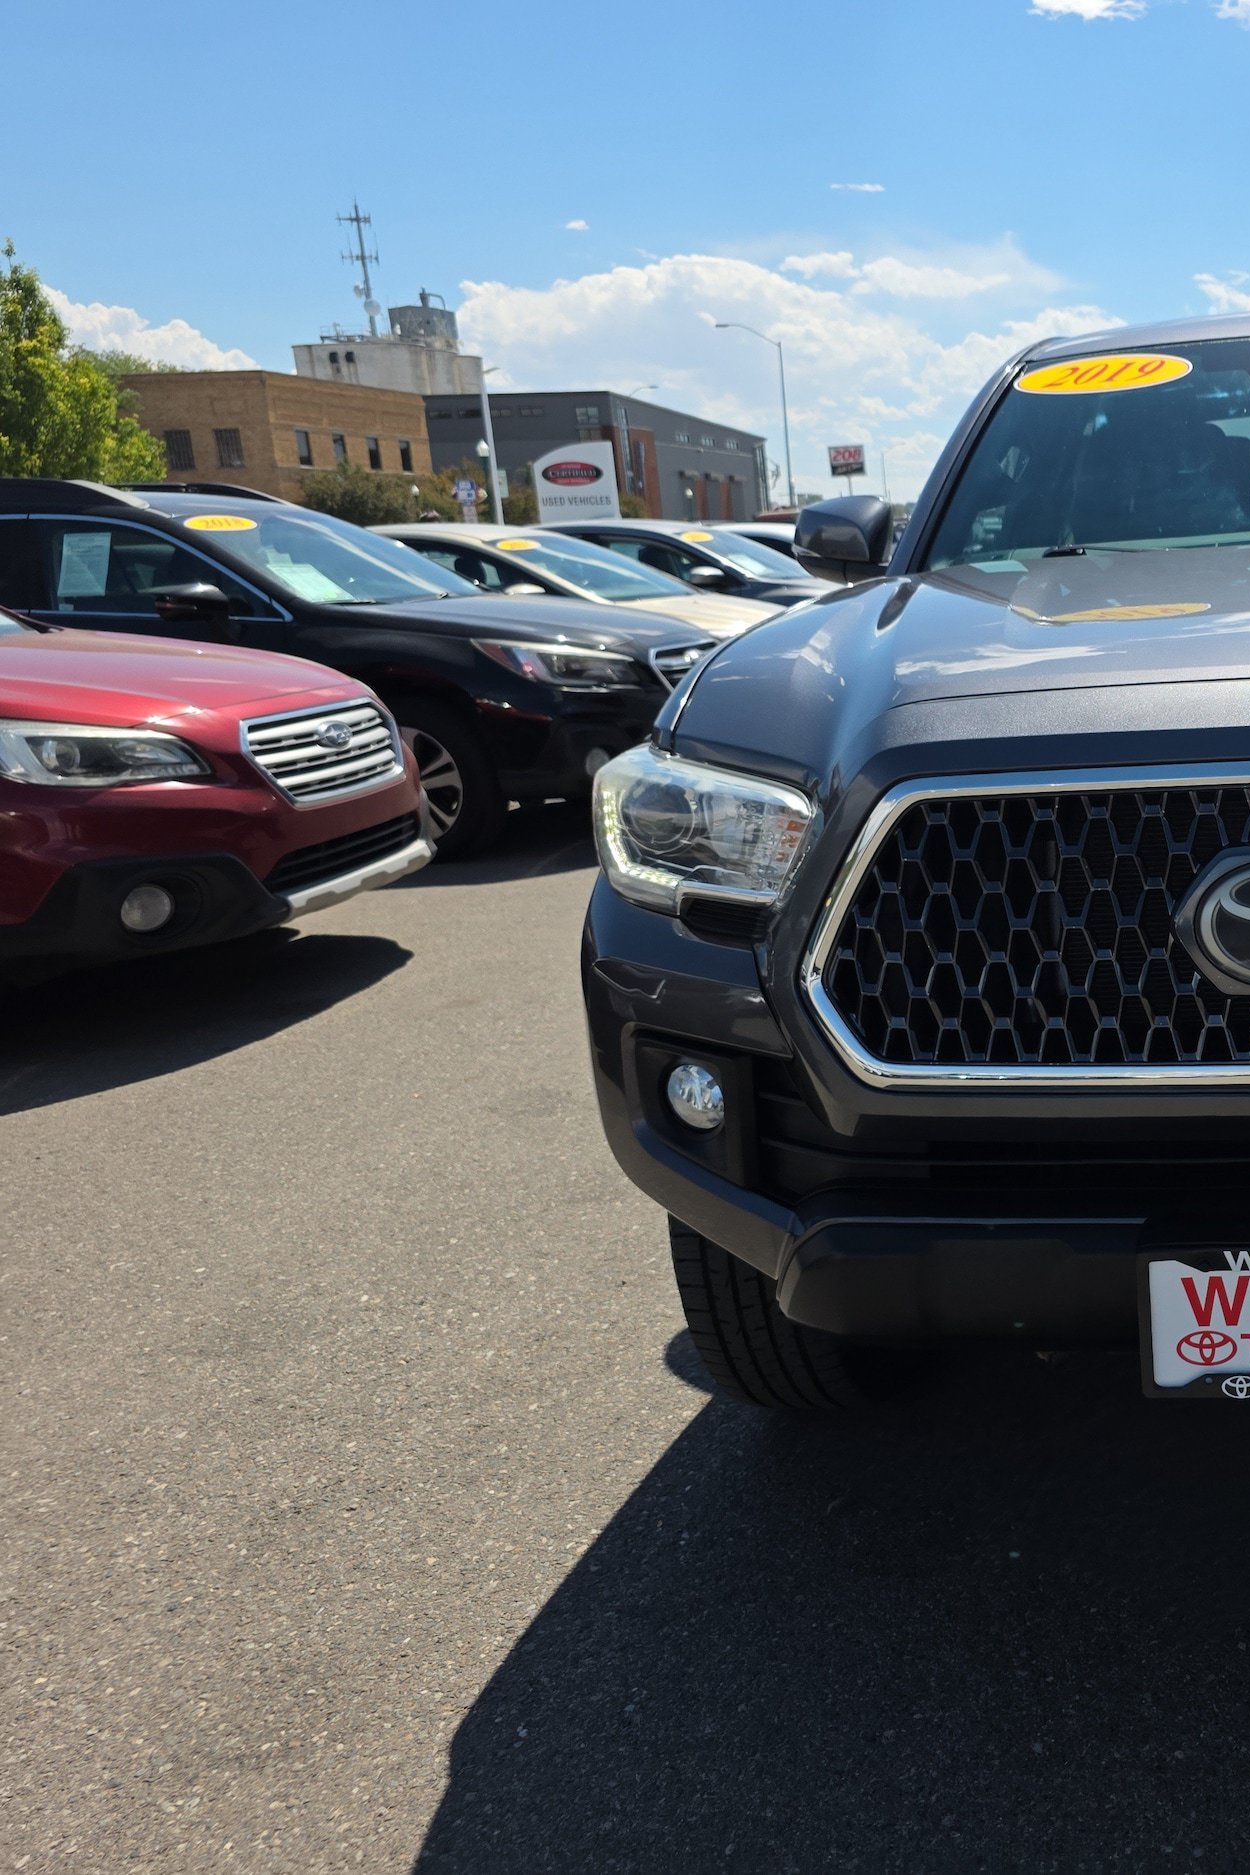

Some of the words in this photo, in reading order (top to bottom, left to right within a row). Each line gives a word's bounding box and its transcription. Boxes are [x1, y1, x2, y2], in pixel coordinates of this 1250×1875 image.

[1042, 358, 1166, 388] 2019
[541, 495, 566, 507] USED
[568, 495, 612, 507] VEHICLES
